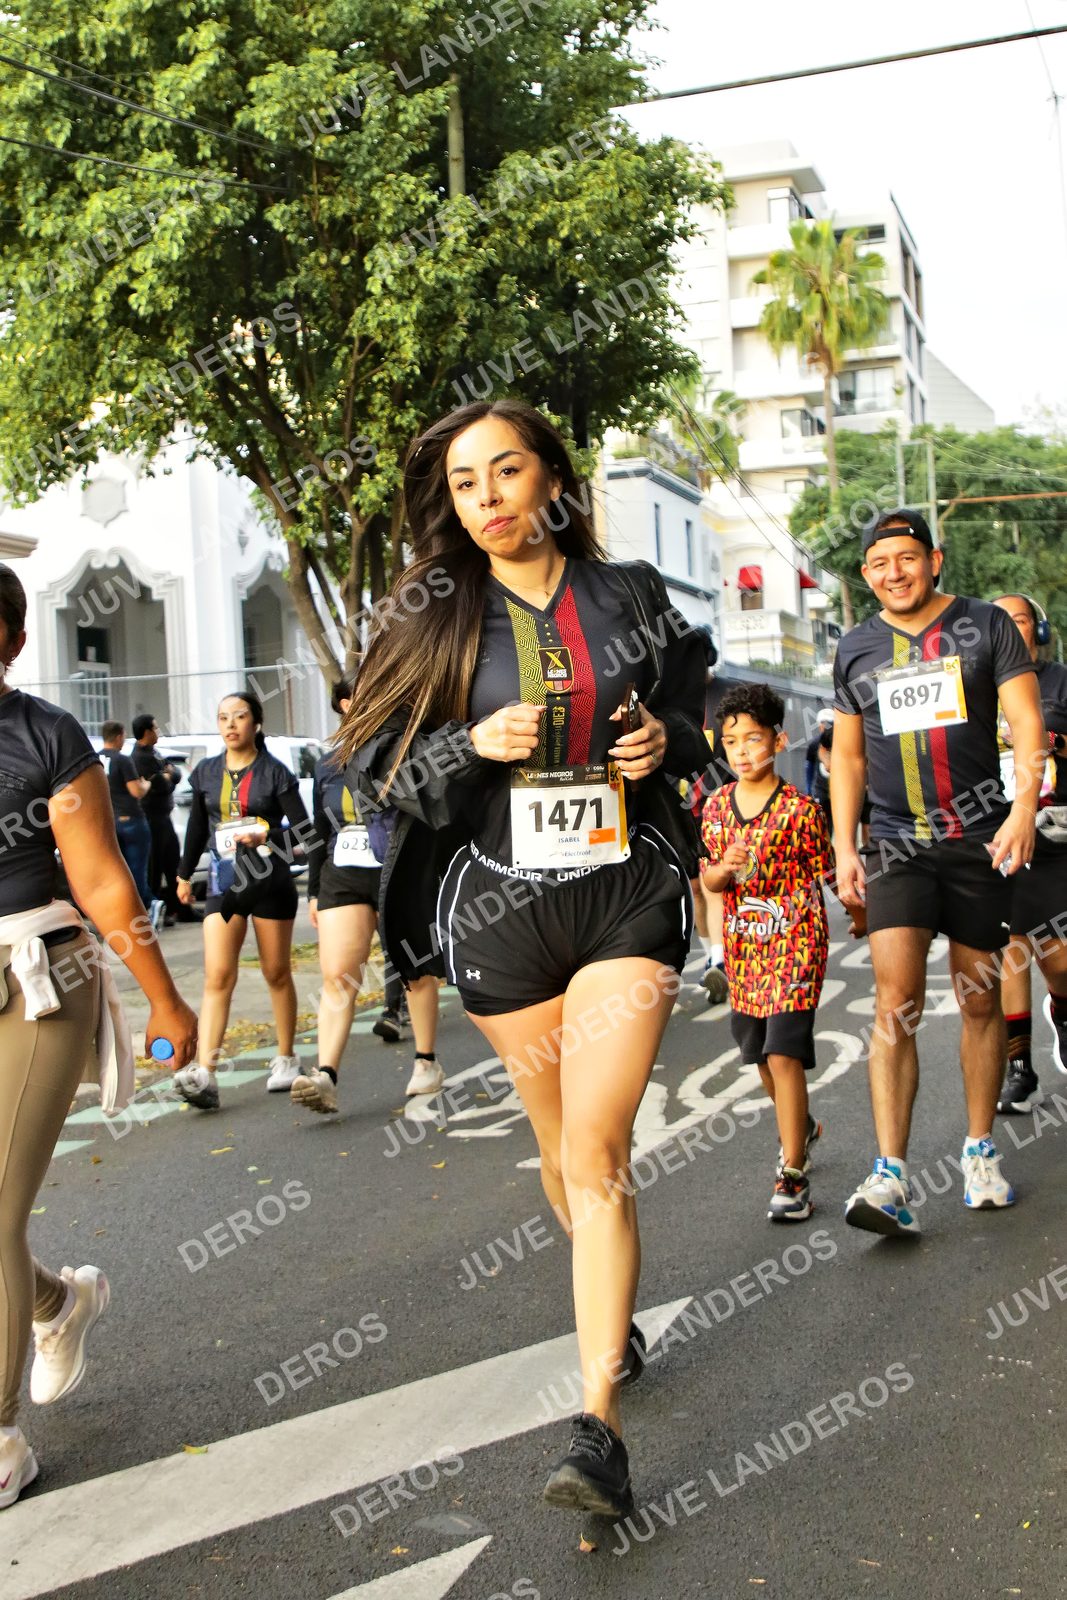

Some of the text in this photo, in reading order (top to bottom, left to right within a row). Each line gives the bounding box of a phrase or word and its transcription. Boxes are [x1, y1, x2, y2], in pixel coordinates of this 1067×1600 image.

[889, 682, 943, 710] 6897
[528, 797, 603, 832] 1471
[478, 855, 542, 882] ARMOUR
